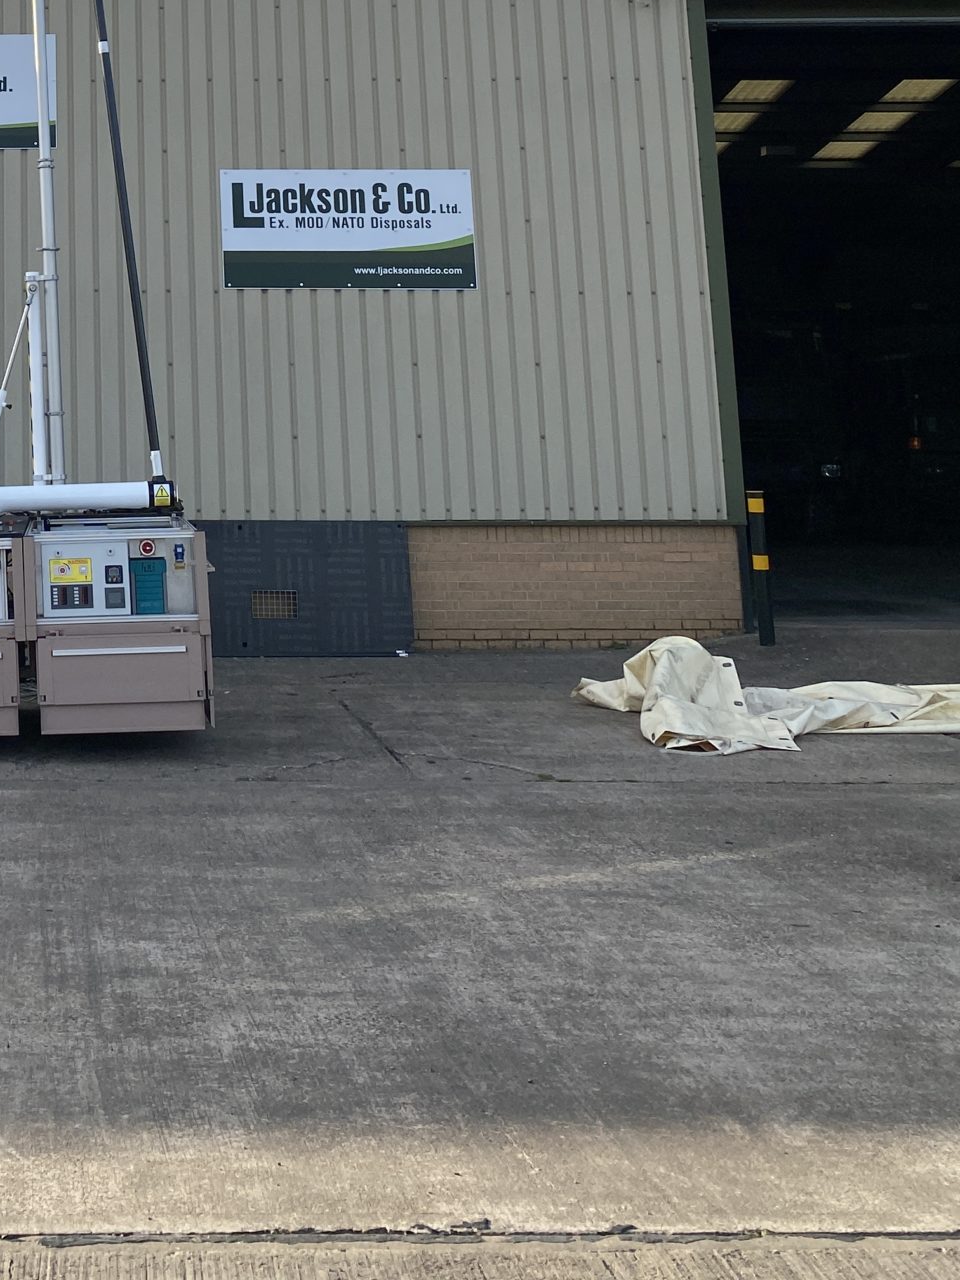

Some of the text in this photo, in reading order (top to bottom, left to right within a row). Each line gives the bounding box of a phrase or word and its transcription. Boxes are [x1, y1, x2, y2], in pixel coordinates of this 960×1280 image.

[373, 183, 390, 214] &
[398, 183, 436, 214] Co.
[440, 204, 461, 214] Ltd.
[270, 217, 431, 230] Ex. MOD/NATO Disposals
[354, 267, 462, 275] www.ljacksonandco.com
